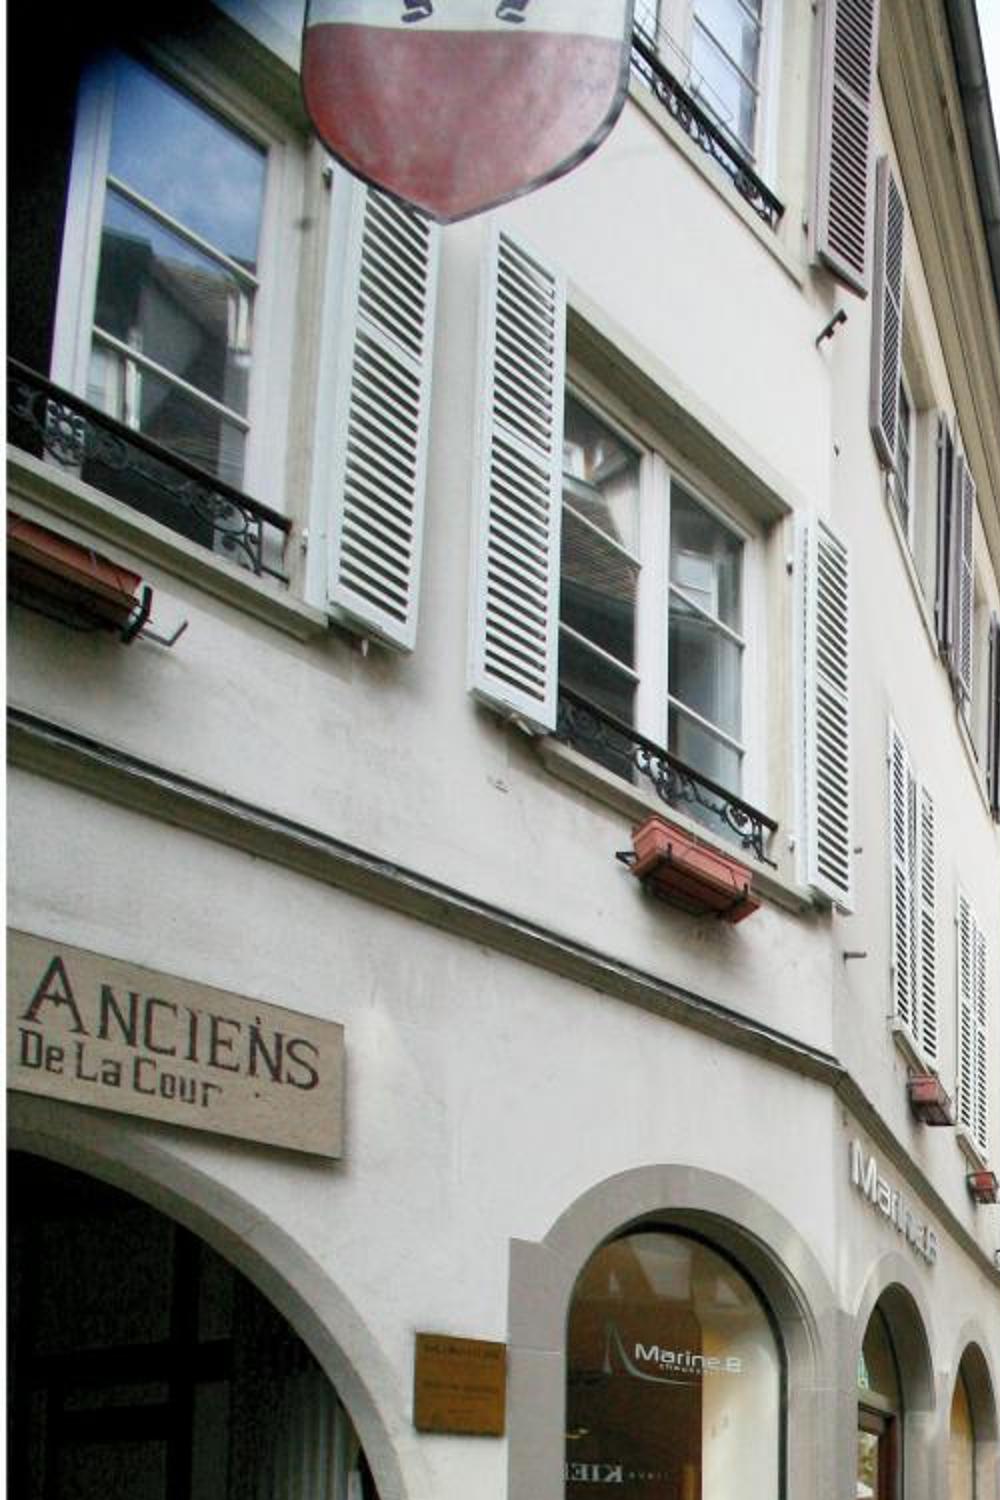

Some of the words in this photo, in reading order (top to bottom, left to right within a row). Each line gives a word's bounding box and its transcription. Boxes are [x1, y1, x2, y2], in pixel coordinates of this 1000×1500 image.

[18, 956, 320, 1091] ANCIENS
[132, 1056, 223, 1107] Cour
[635, 1343, 720, 1368] Marine
